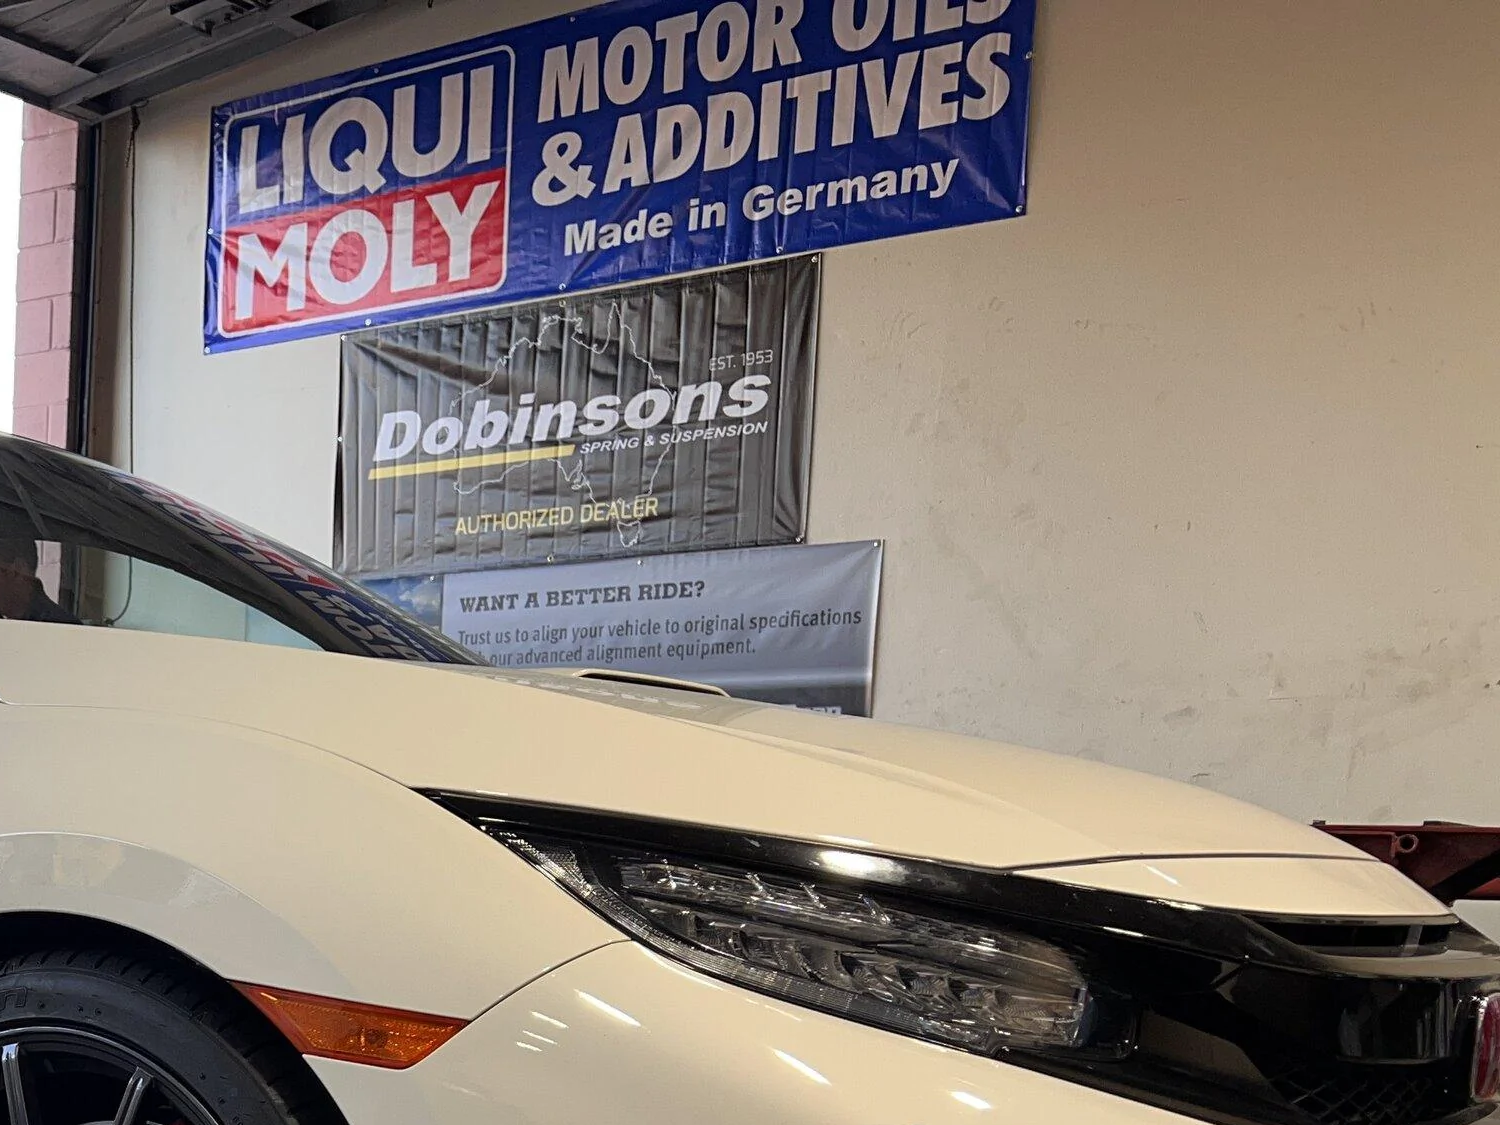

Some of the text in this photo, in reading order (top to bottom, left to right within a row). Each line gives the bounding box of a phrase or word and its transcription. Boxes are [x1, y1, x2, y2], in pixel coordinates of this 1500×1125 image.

[537, 0, 802, 124] MOTOR
[236, 64, 495, 214] LIQUI
[532, 32, 1012, 207] & ADDITIVES
[563, 158, 960, 256] Made in Germany
[232, 180, 501, 320] MOLY
[708, 349, 774, 371] EST. 1953
[372, 374, 772, 462] Dobinsons
[579, 421, 768, 455] SPRING & SUSPENSION
[454, 497, 659, 536] AUTHORIZED DEALER
[458, 608, 862, 646] Trust us to align your vehicle to original specifications
[460, 580, 706, 613] WANT A BETTER RIDE?
[489, 651, 514, 666] our
[516, 645, 582, 664] advanced
[586, 642, 662, 664] alignment
[667, 638, 756, 660] equipment.
